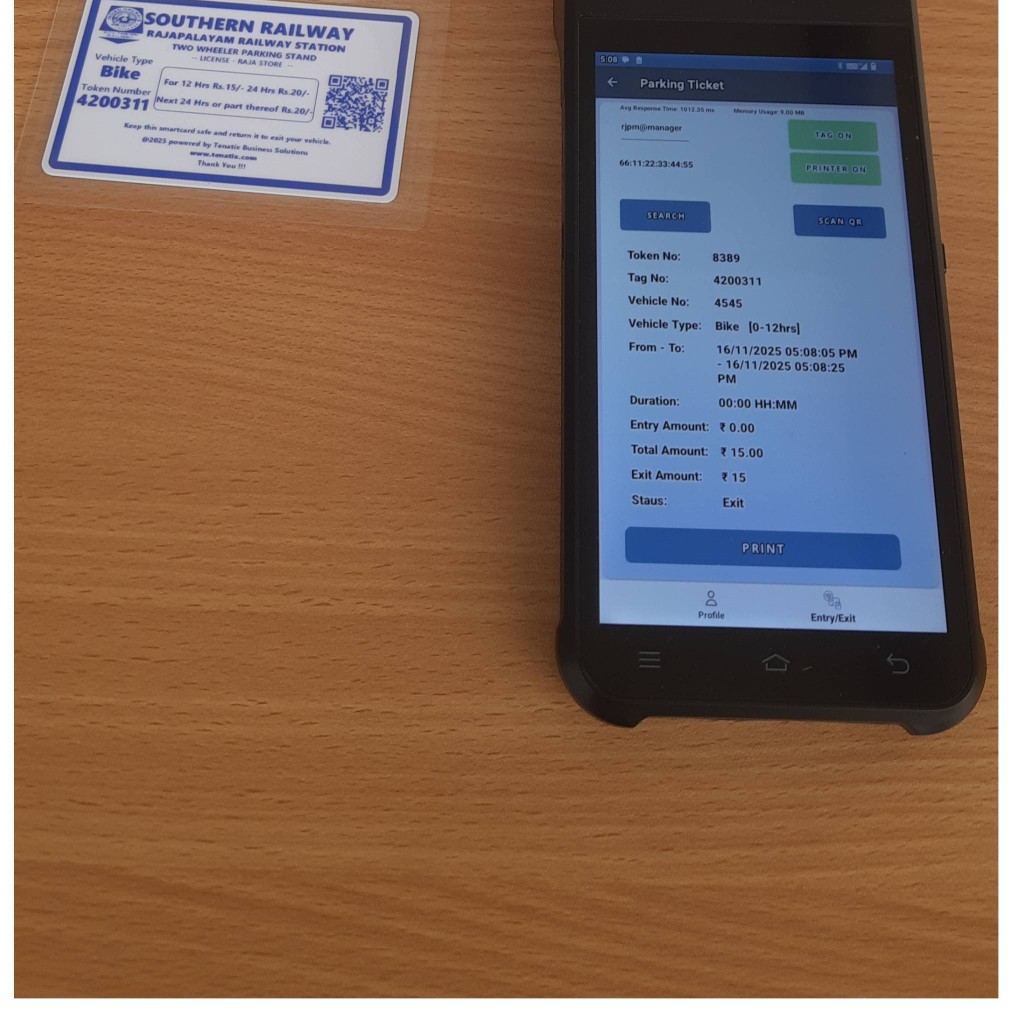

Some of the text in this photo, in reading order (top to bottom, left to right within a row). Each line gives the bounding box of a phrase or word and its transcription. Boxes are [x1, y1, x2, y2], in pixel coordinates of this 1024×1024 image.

[144, 12, 355, 41] SOUTHERN RAILWAY
[146, 30, 235, 45] RAJAPALAYAM
[238, 37, 292, 49] RAILWAY
[294, 41, 346, 53] STATION
[95, 52, 154, 66] Vehicle Type
[172, 43, 317, 62] TWO WHEELER PARKING STAND
[199, 56, 283, 68] LICENSE RAJA STORE
[100, 64, 141, 80] Bike
[81, 83, 152, 96] Token Number
[163, 78, 179, 87] For
[181, 80, 192, 88] 12
[194, 81, 210, 89] Hrs
[246, 85, 258, 93] 24
[260, 86, 276, 95] Hrs
[640, 78, 725, 91] Parking Ticket
[76, 93, 150, 111] 4200311
[156, 95, 178, 105] Next
[179, 97, 192, 106] 24
[193, 99, 210, 107] Hrs
[223, 103, 246, 111] part
[246, 103, 280, 113] thereof
[632, 105, 661, 113] Response
[733, 108, 757, 116] Memory
[123, 122, 142, 130] Keep
[143, 123, 157, 131] this
[159, 125, 196, 134] smartcard
[228, 131, 252, 139] return
[304, 137, 332, 145] vehicle.
[621, 123, 683, 133] rjpm@manager
[815, 131, 853, 140] TAG ON
[168, 139, 201, 148] powered
[202, 141, 211, 149] by
[214, 142, 240, 150] Tenatix
[242, 145, 273, 153] Business
[274, 147, 309, 156] Solutions
[189, 151, 258, 161] www.tenatix.com
[197, 160, 236, 169] Thank You
[619, 159, 694, 169] 66:11:22:33:44:55
[806, 164, 867, 174] PRINTER ON
[646, 211, 686, 221] SEARCH
[818, 217, 863, 227] SCAN QR
[627, 251, 741, 263] Token No: 8389
[628, 273, 763, 287] Tag No: 4200311
[628, 296, 743, 309] Vehicle No: 4545
[628, 318, 801, 335] Vehicle Type: Bike [0-12hrs]
[628, 342, 858, 359] From To: 16/11/2025 05:08:05 PM
[725, 359, 845, 373] 16/11/2025 05:08:25
[717, 373, 737, 385] PM
[629, 395, 798, 410] Duration: 00:00 HH:MM
[630, 420, 755, 434] Entry Amount: 0.00
[630, 444, 764, 458] Total Amount: 15.00
[631, 469, 746, 483] Exit Amount: 15
[631, 494, 745, 509] Staus: Exit
[741, 542, 786, 555] PRINT
[698, 610, 856, 624] Profile Entry/Exit
